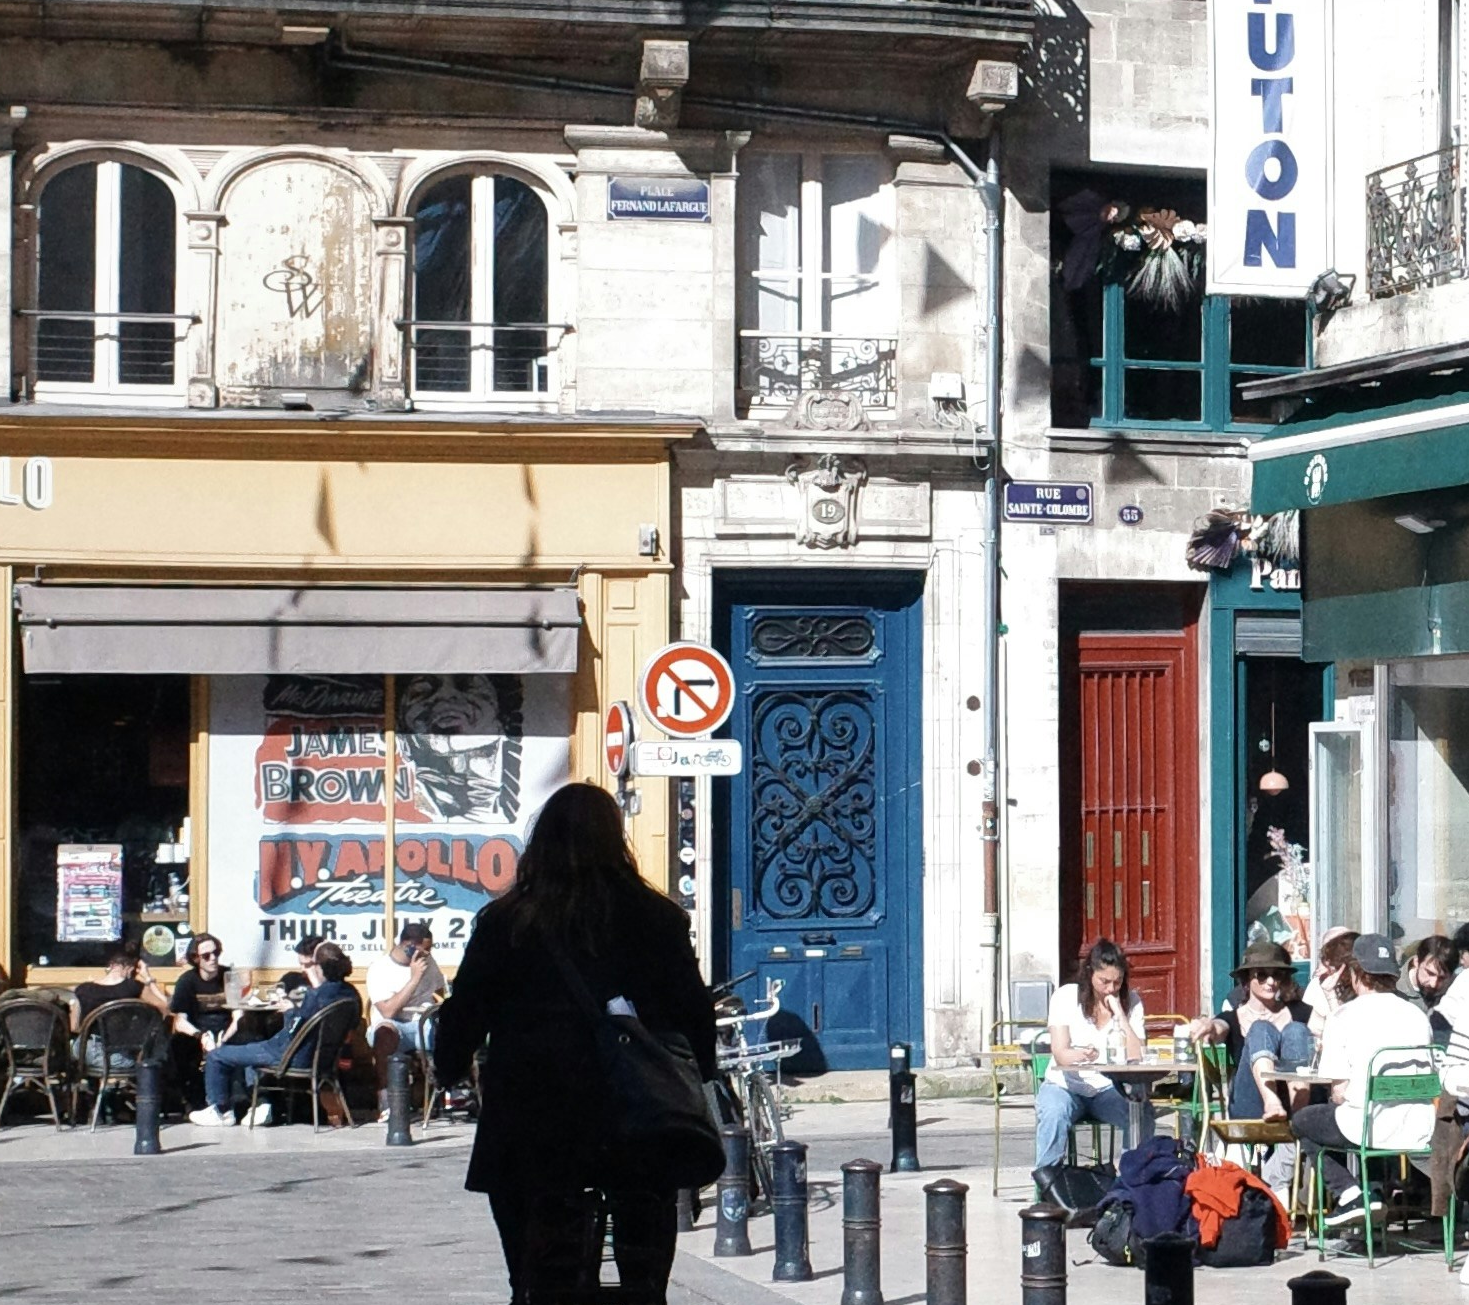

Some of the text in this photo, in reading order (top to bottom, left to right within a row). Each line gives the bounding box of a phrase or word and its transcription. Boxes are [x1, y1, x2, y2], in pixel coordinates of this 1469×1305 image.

[640, 185, 674, 197] PLACE
[611, 200, 707, 213] FERNAND LAFARGUE
[1036, 487, 1061, 500] RUE
[821, 504, 836, 518] 19
[1008, 502, 1088, 516] SAINTE-COLOMBE
[1123, 509, 1139, 521] 55
[261, 763, 412, 803] BROWN
[334, 838, 518, 892] APOLLO
[307, 874, 445, 909] Theatre
[259, 919, 347, 941] THUR.
